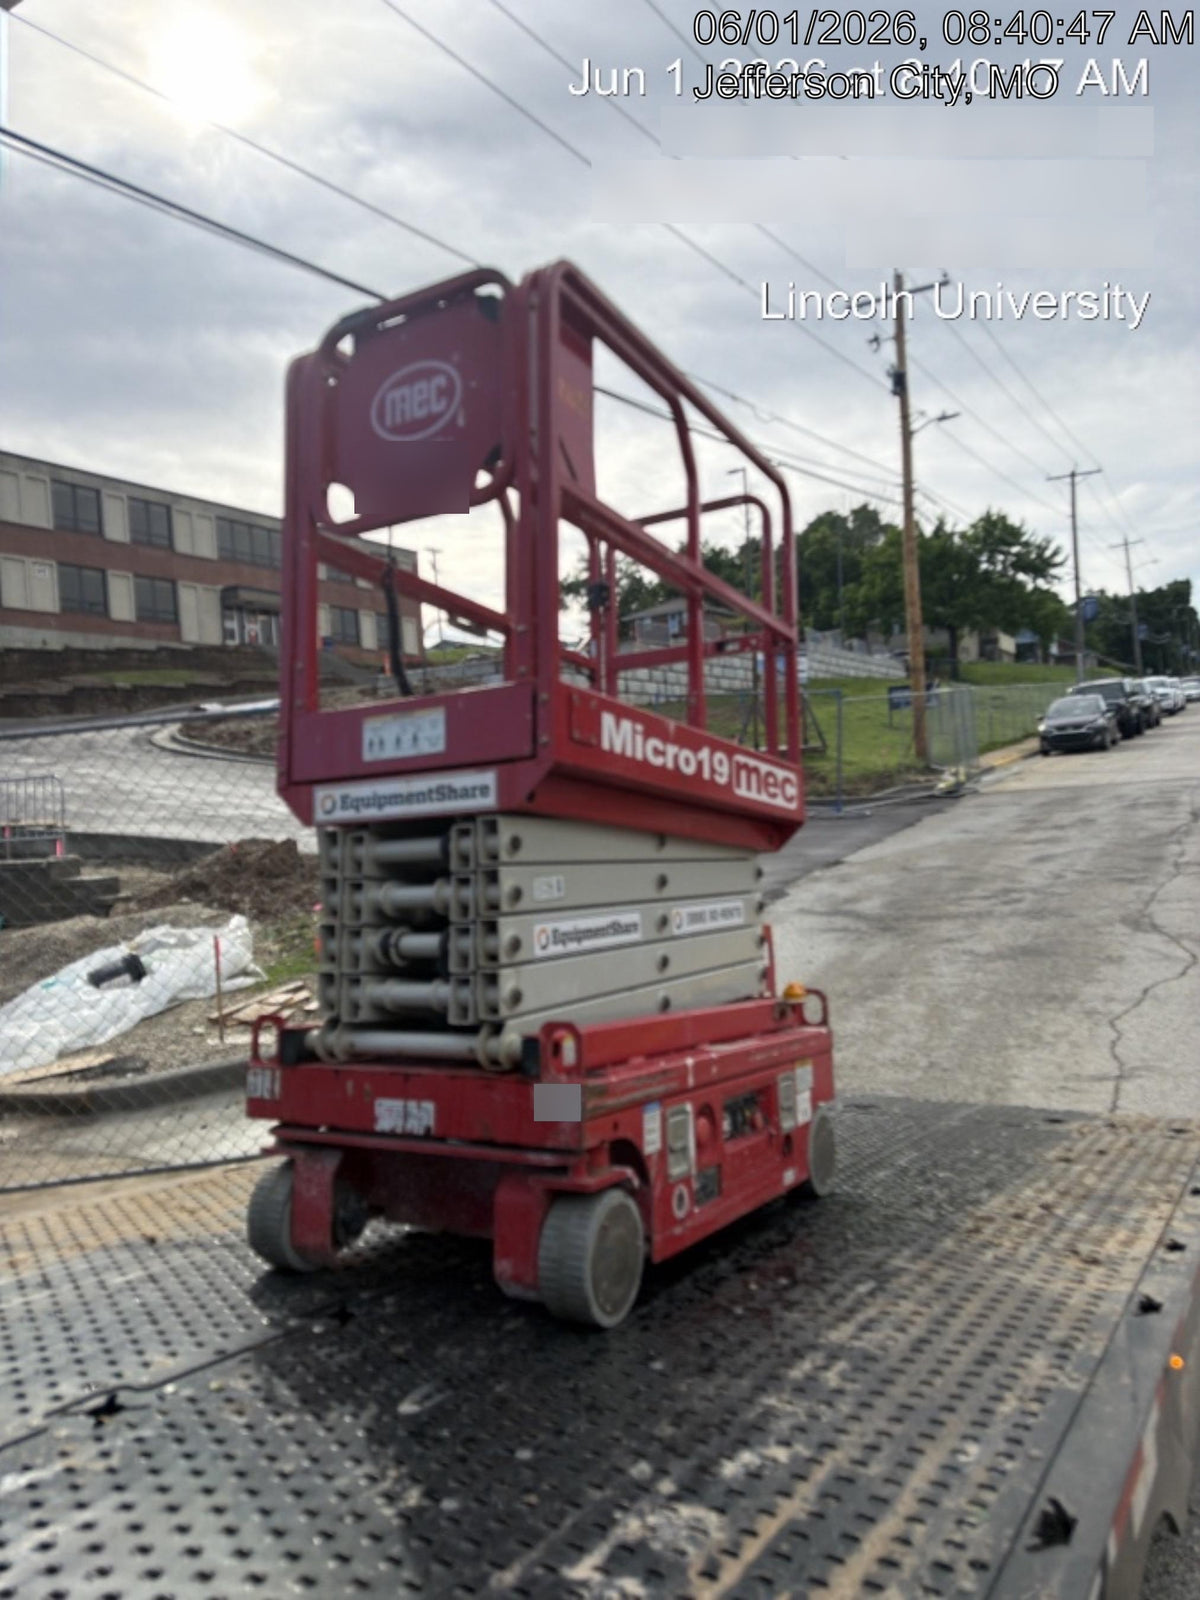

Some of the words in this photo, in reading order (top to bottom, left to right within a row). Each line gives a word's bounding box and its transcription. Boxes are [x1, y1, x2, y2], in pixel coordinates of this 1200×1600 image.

[601, 711, 729, 785] Micro19
[735, 758, 797, 804] mec
[340, 783, 490, 813] EquipmentShare
